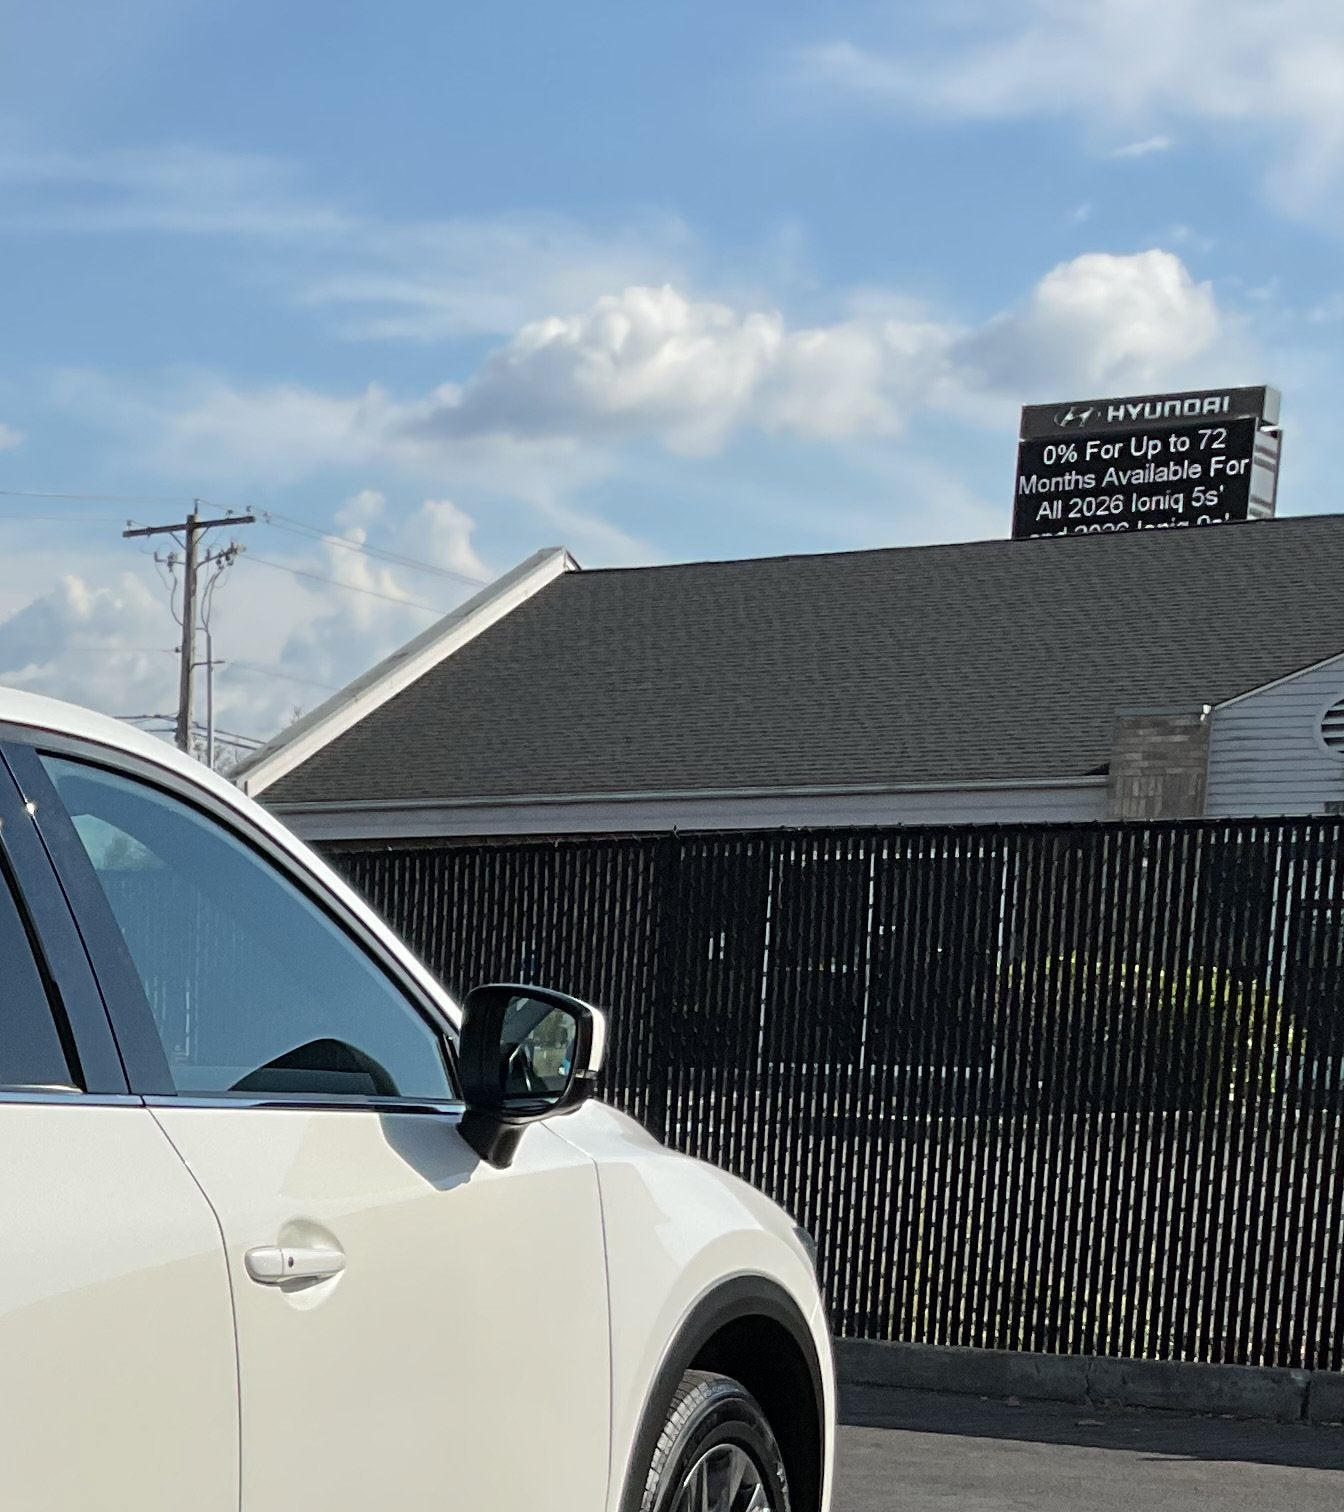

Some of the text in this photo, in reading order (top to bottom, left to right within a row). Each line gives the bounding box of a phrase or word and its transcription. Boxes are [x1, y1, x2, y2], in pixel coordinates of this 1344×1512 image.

[1107, 395, 1229, 422] HYUNDAI
[1043, 428, 1227, 465] 0% For Up to 72
[1019, 455, 1249, 495] Months Available For
[1035, 499, 1062, 521] All
[1068, 494, 1123, 518] 2026
[1131, 490, 1183, 513] Ioniq
